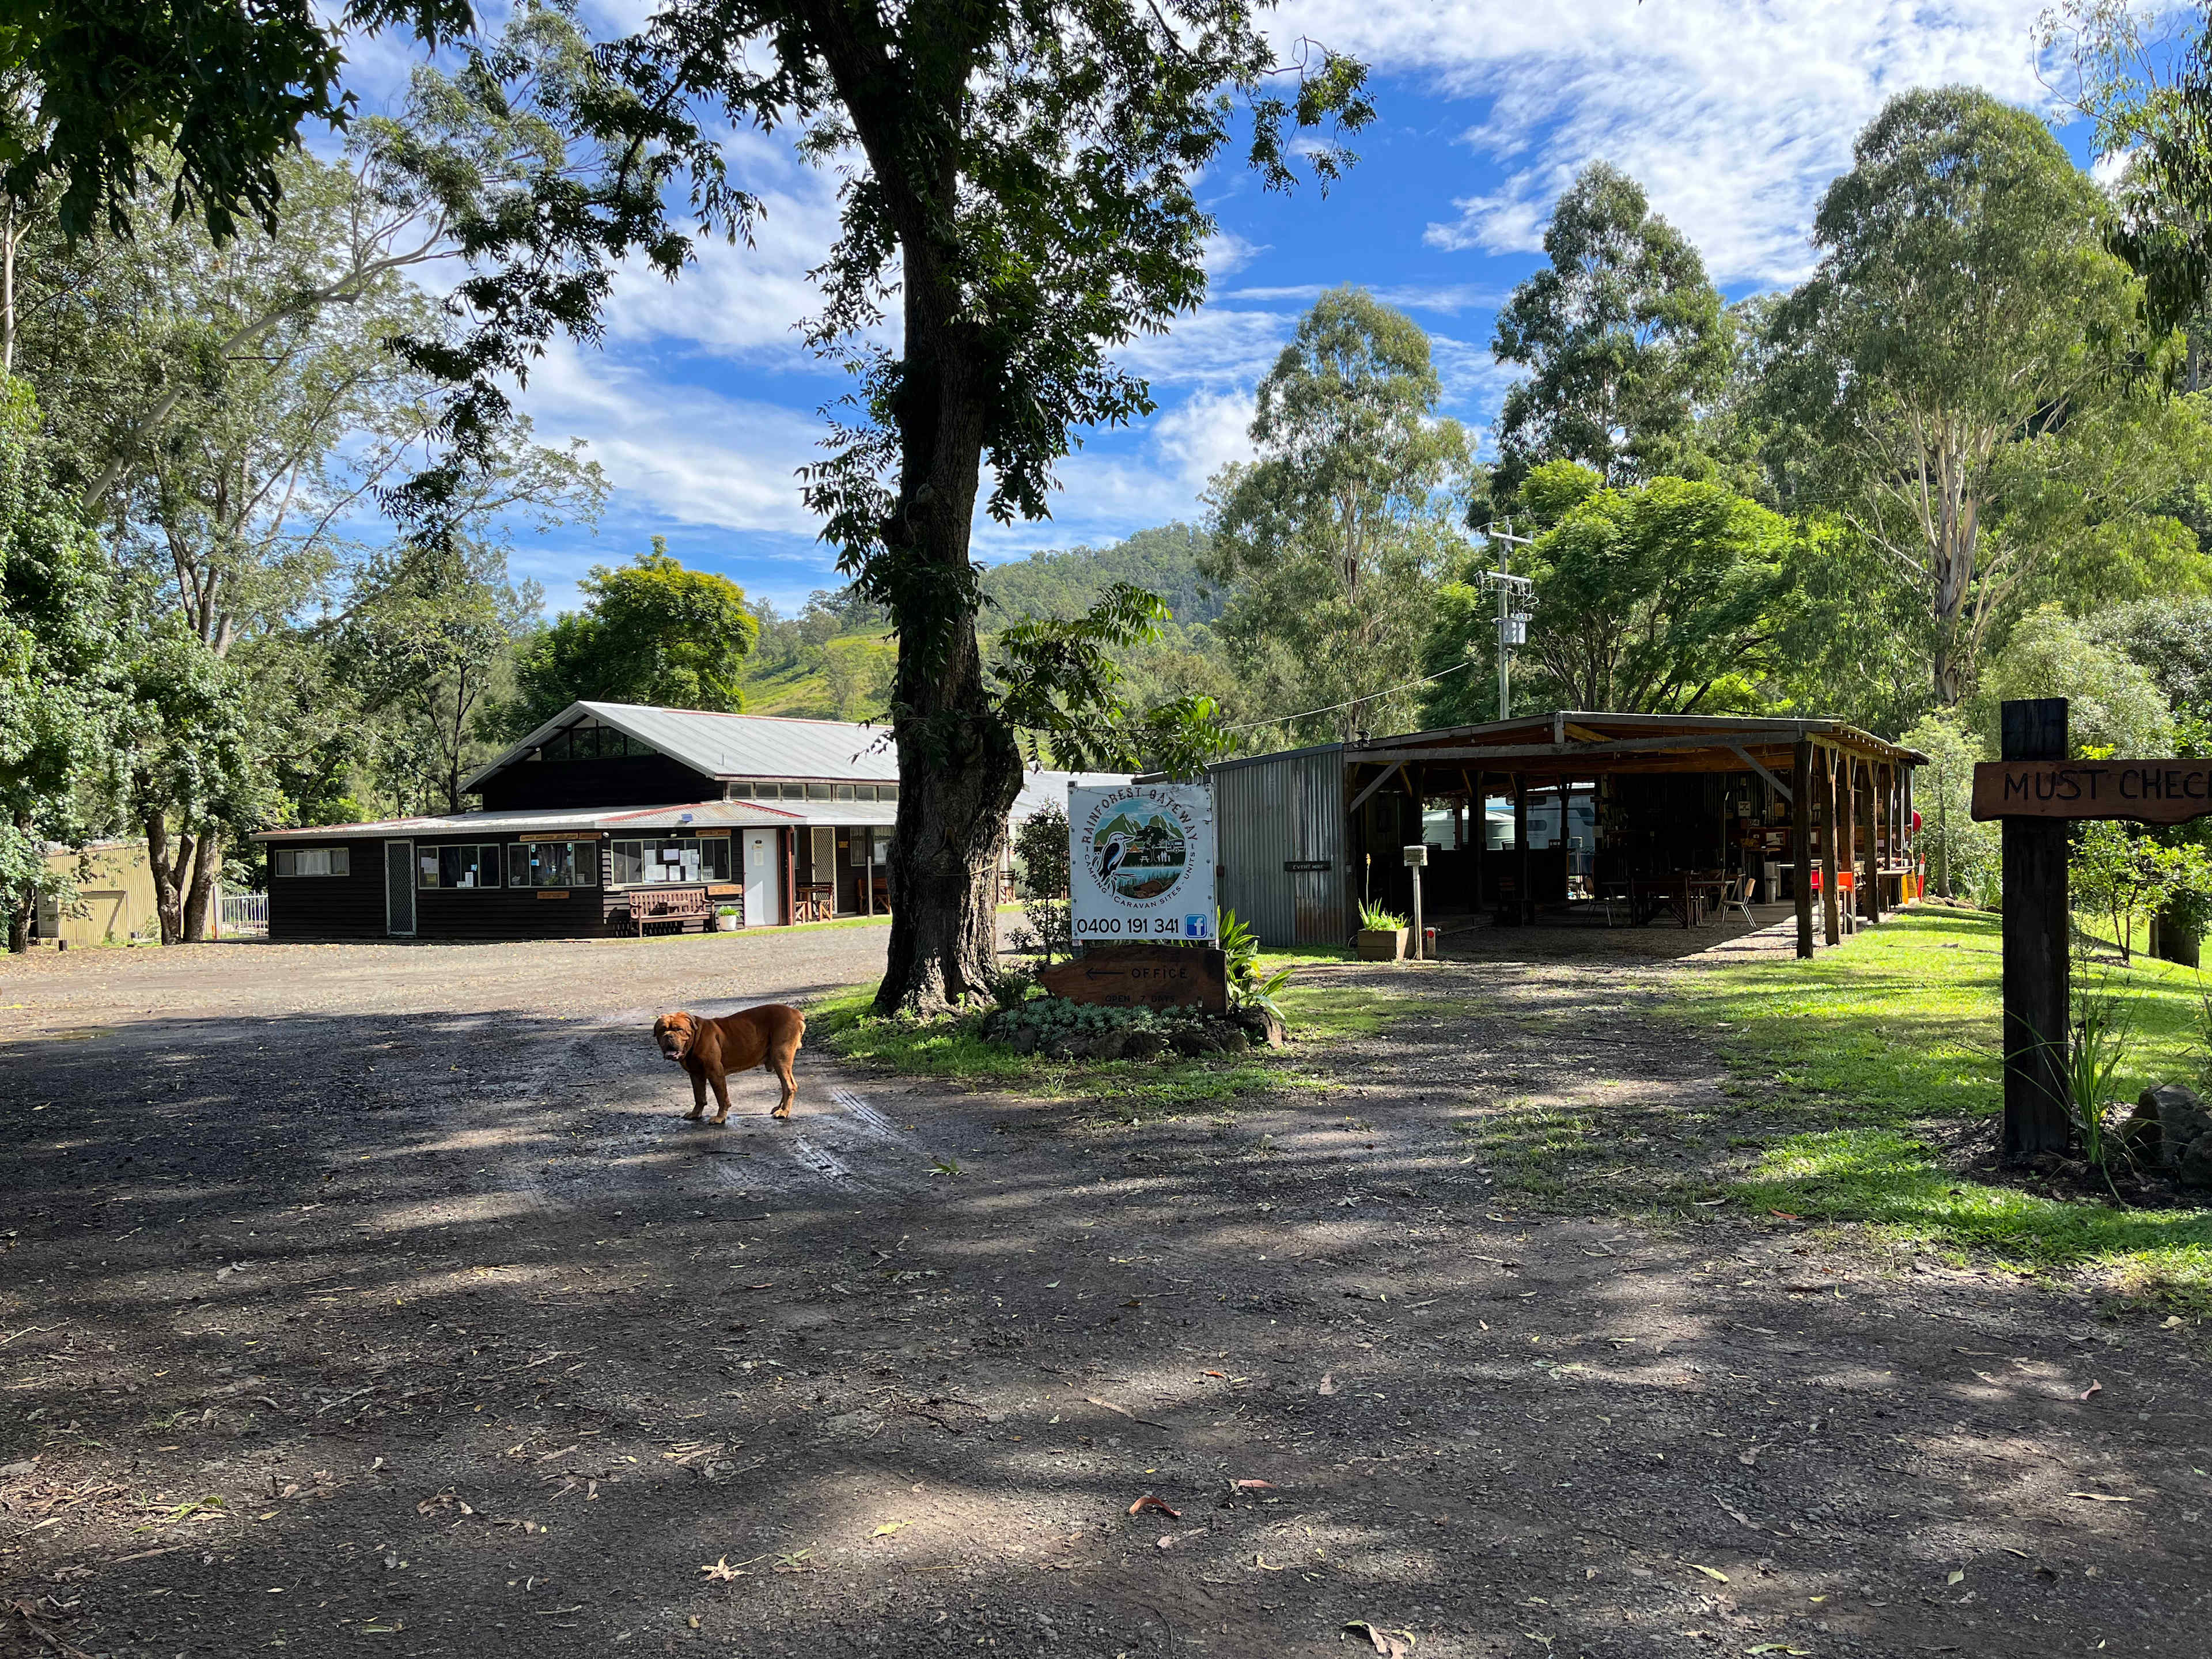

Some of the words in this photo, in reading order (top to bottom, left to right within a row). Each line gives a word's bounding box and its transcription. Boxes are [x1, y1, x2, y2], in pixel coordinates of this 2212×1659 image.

[2004, 769, 2108, 800] MUST
[2120, 768, 2212, 799] CHEC
[1082, 787, 1142, 843] RAINFOREST
[1150, 790, 1198, 840] GATEWAY
[1085, 854, 1107, 893] CAMPING
[1114, 896, 1157, 908] CARAVAN
[1160, 886, 1181, 904] SITES
[1184, 853, 1195, 879] UNITS
[1077, 918, 1120, 933] 0400
[1127, 918, 1147, 933] 191
[1154, 918, 1179, 933] 341
[1194, 917, 1203, 935] f
[1131, 968, 1188, 979] OFFICE
[1152, 995, 1175, 1003] DAYS
